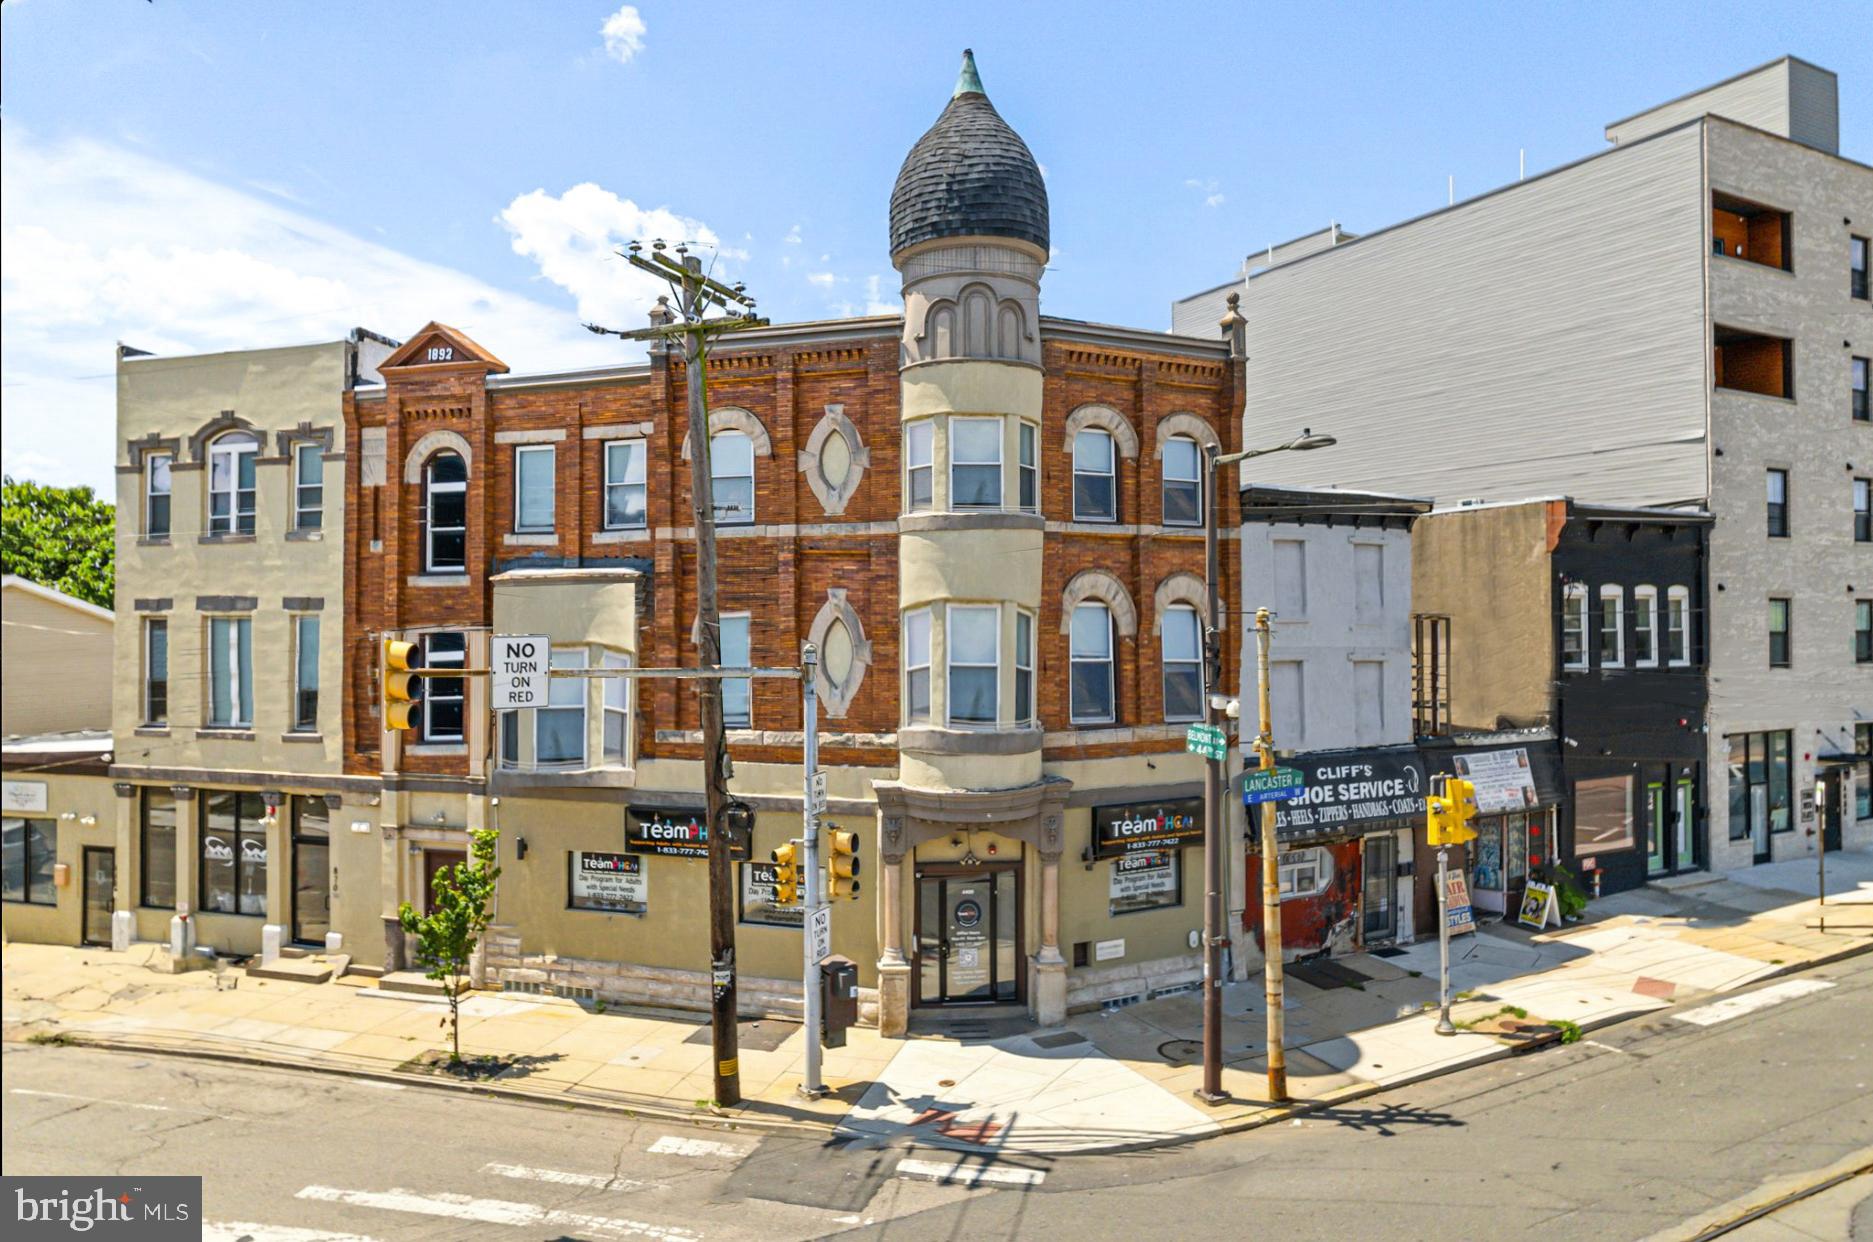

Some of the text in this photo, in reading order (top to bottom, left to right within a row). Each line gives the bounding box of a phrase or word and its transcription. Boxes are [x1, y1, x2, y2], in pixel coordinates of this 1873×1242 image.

[427, 347, 453, 361] 1892
[507, 643, 535, 658] NO
[504, 661, 537, 674] TURN
[511, 676, 531, 689] ON
[509, 690, 534, 703] RED
[1316, 765, 1373, 780] CLIFF'S
[1244, 774, 1293, 793] LANCASTER
[1247, 794, 1253, 803] E
[1259, 791, 1288, 800] ARTERIAL
[1338, 779, 1405, 802] SERVICE
[1290, 808, 1314, 826] HEELS
[1317, 804, 1349, 823] ZIPPERS
[1351, 800, 1390, 819] HANDBAGS
[1391, 797, 1415, 815] COATS
[590, 875, 614, 883] Program
[599, 884, 617, 892] Special
[619, 886, 636, 894] Needs
[814, 912, 826, 928] NO
[813, 926, 828, 939] TURN
